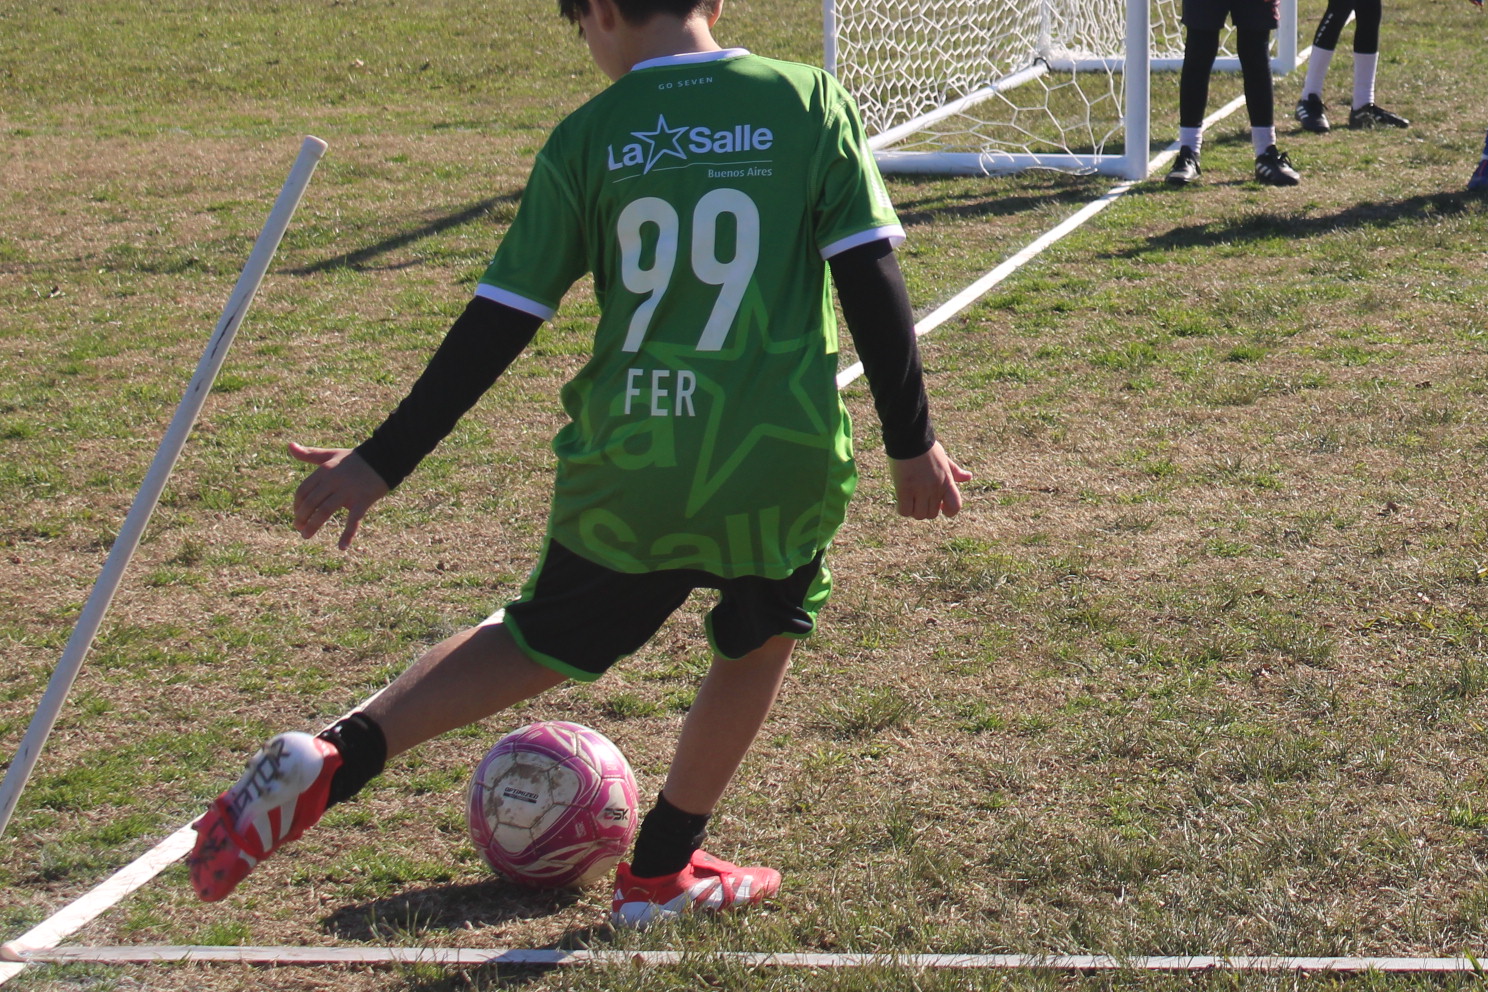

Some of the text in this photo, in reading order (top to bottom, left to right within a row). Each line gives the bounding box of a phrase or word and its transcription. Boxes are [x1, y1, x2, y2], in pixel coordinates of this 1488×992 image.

[658, 76, 713, 90] GO SEVEN
[607, 124, 774, 171] La Salle
[708, 166, 773, 178] Buenos Aires
[617, 188, 760, 353] 99
[624, 368, 697, 417] FER
